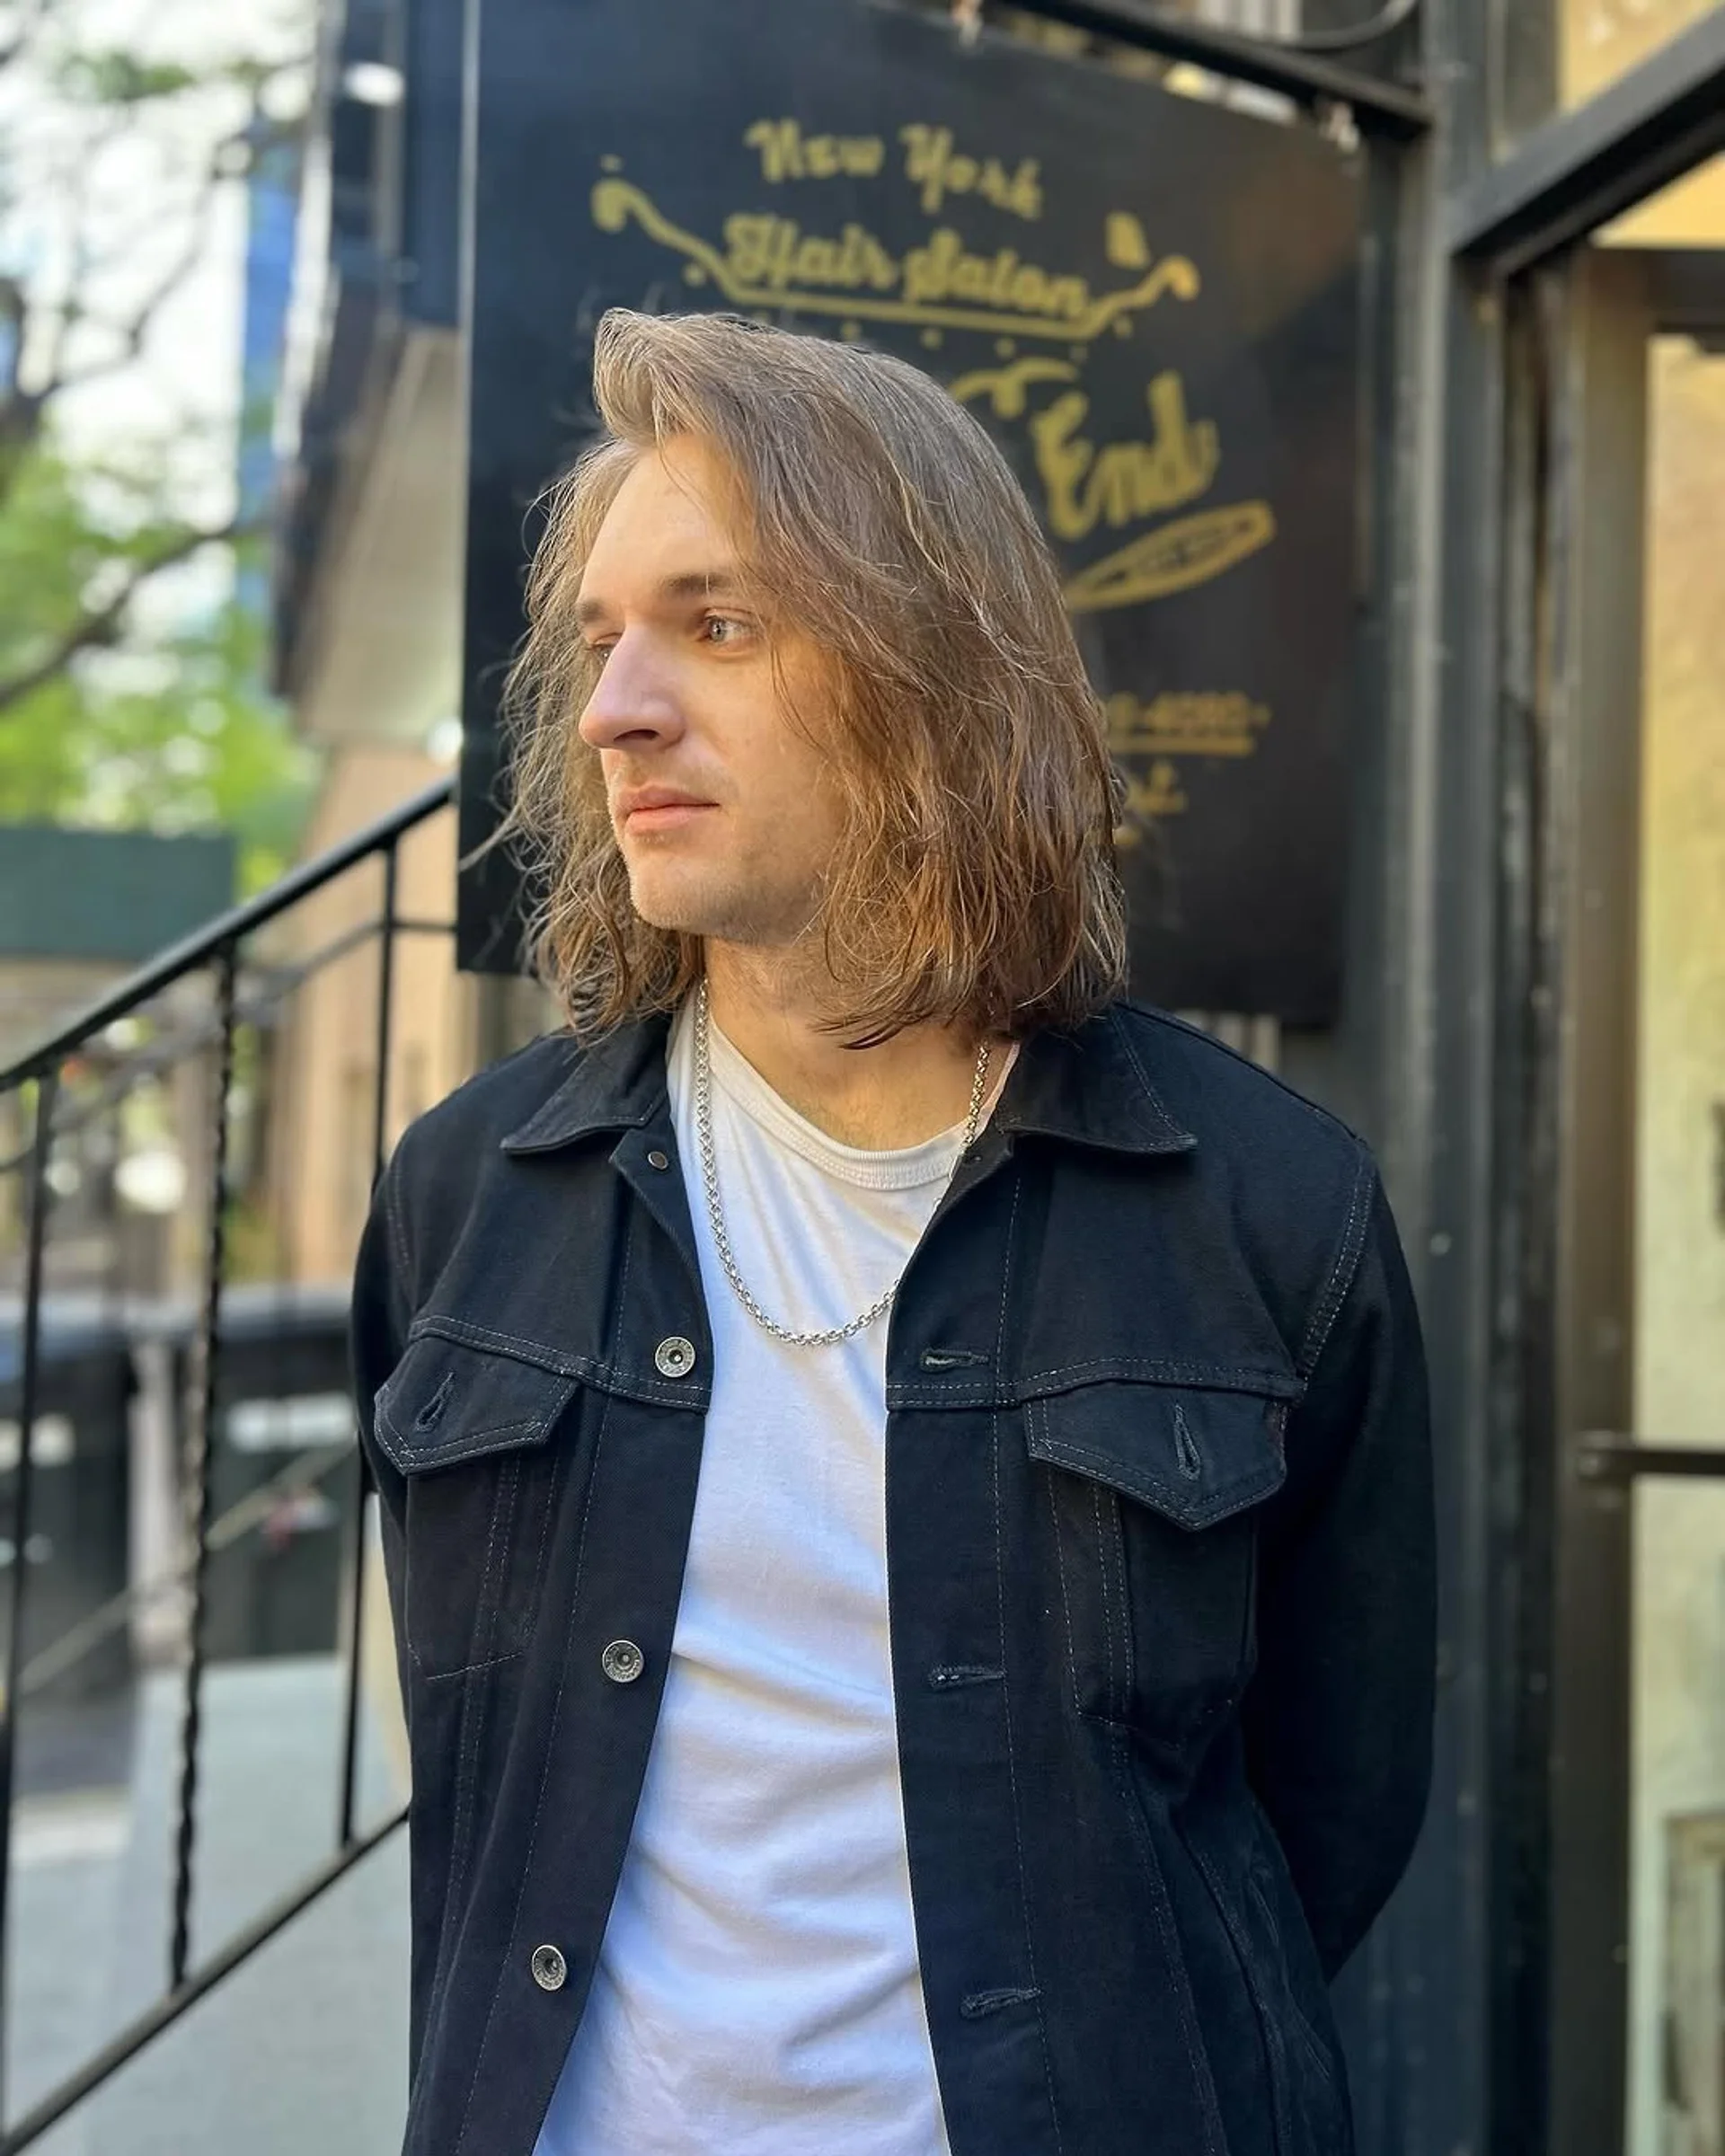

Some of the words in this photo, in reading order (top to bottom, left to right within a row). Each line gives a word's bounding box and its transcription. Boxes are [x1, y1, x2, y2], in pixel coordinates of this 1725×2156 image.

[747, 119, 883, 181] New
[902, 124, 1040, 218] York
[725, 213, 899, 291] Hair
